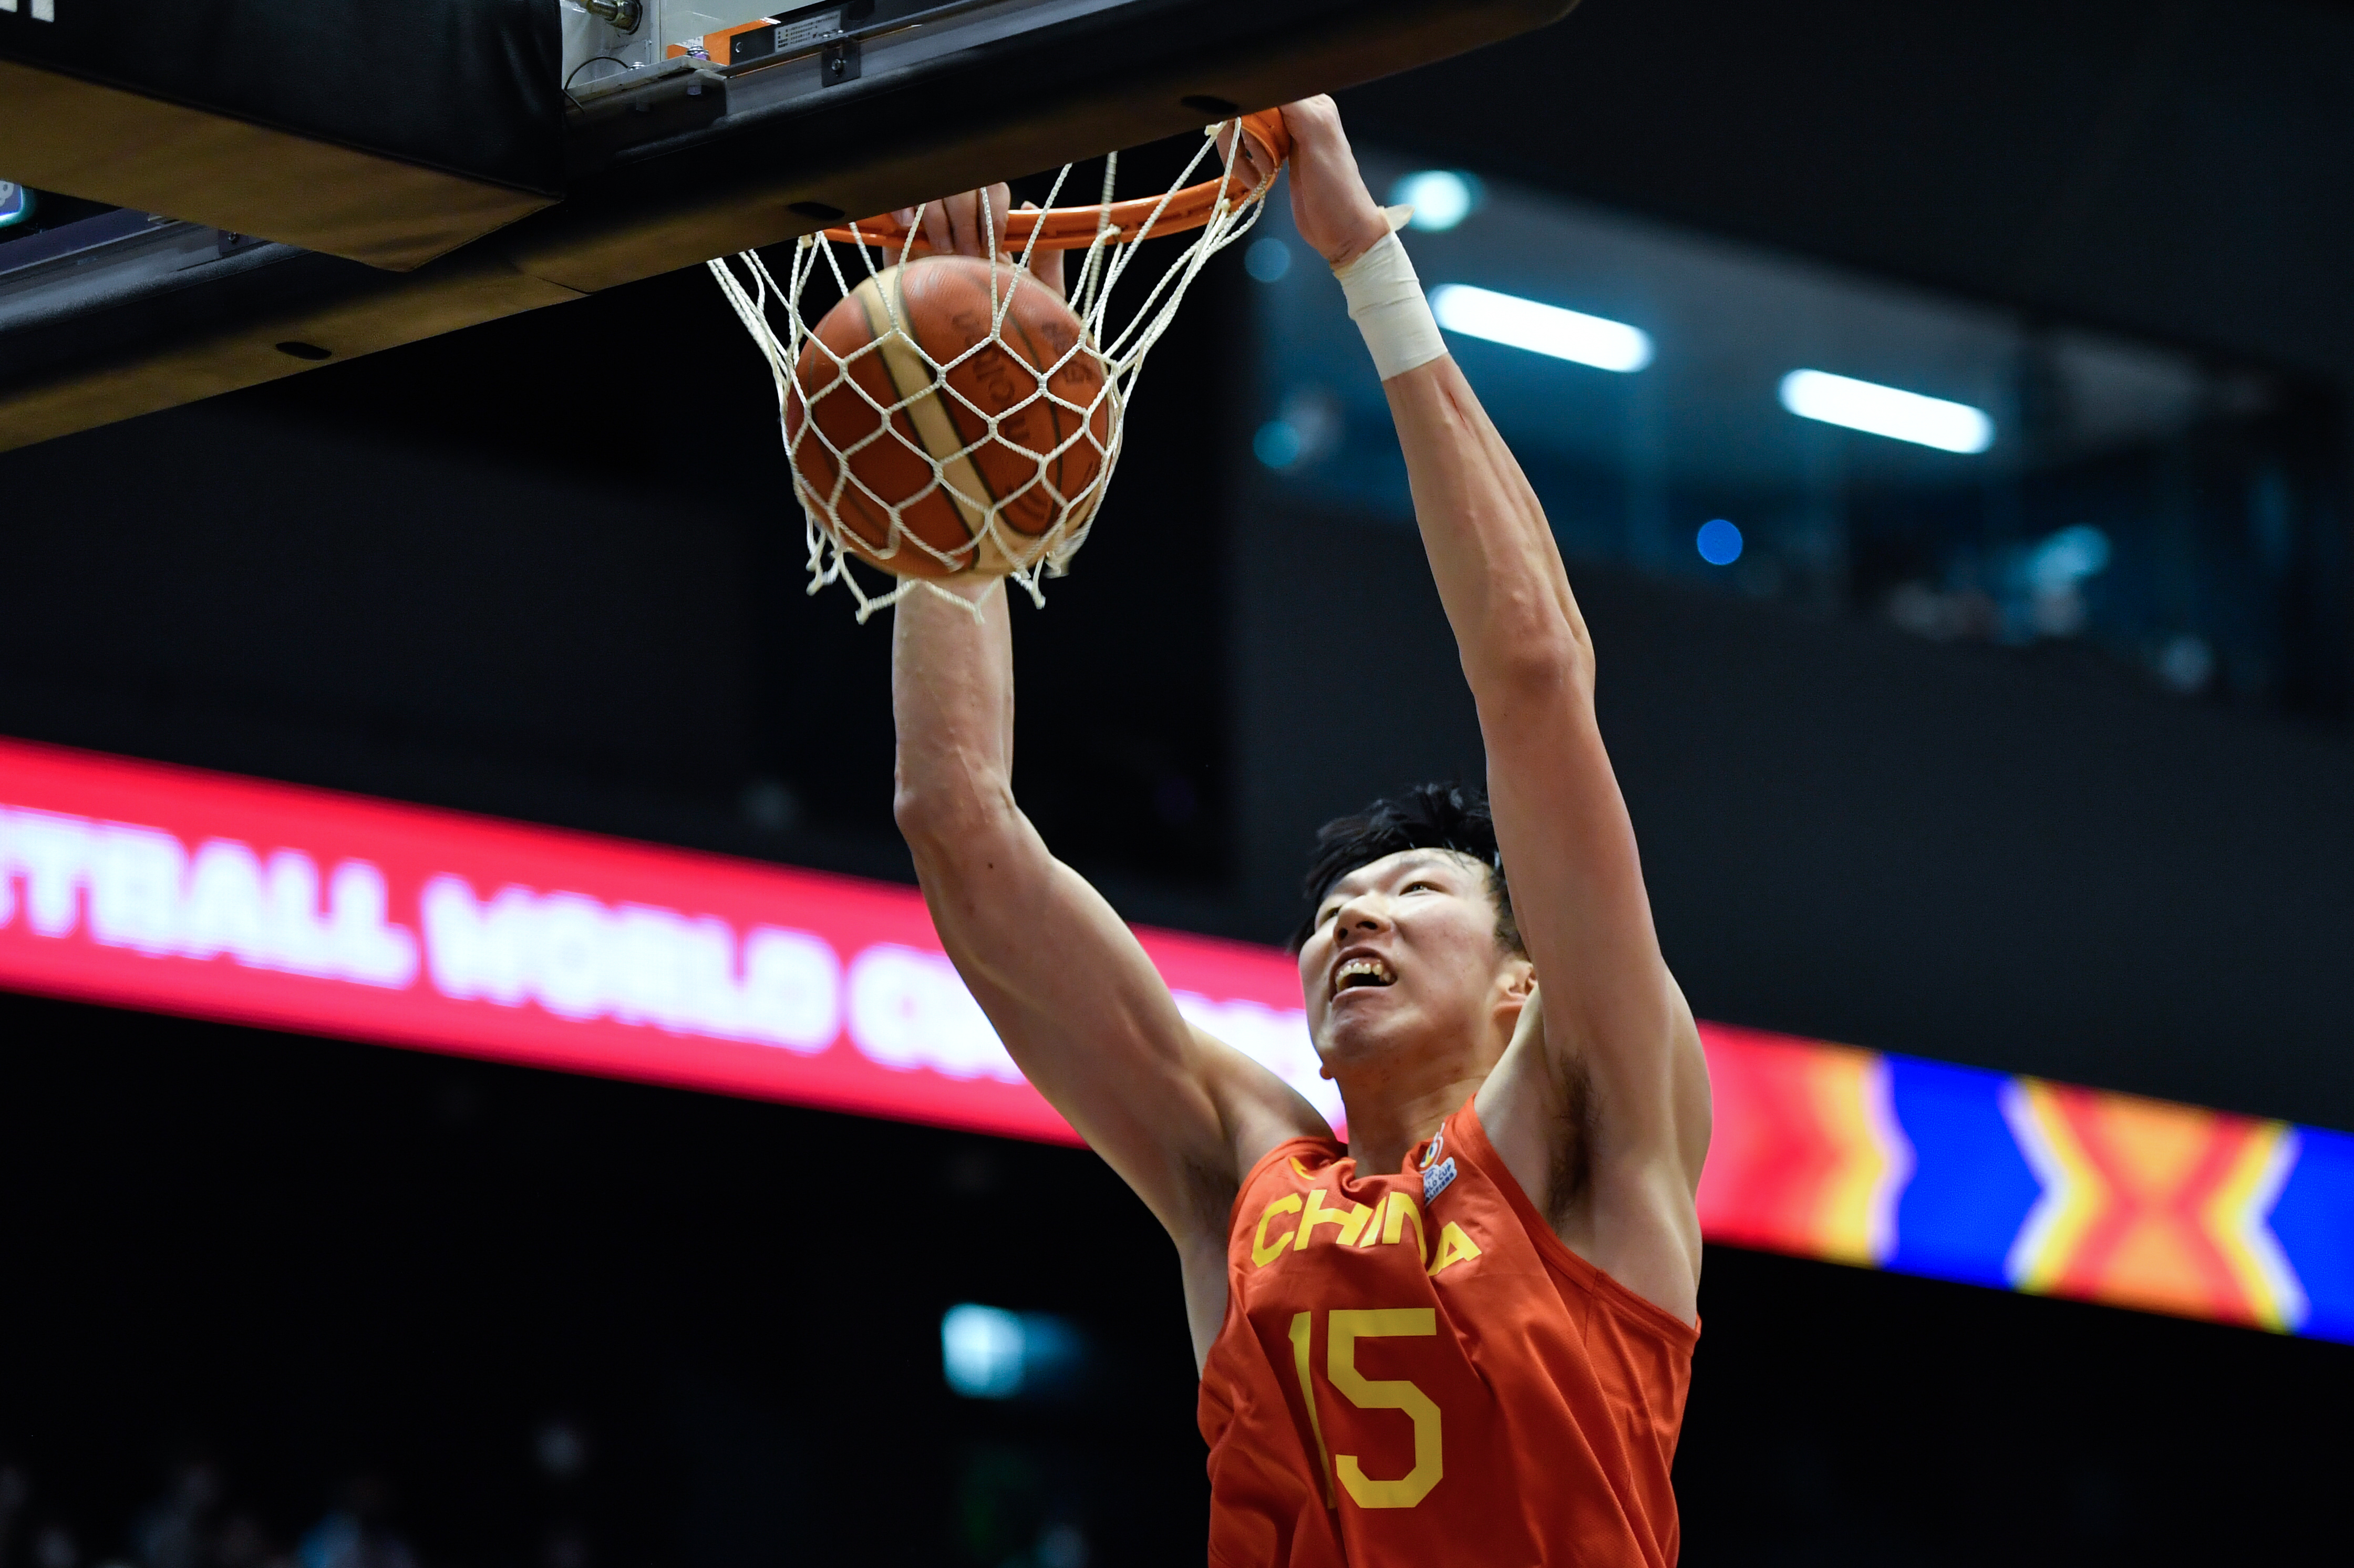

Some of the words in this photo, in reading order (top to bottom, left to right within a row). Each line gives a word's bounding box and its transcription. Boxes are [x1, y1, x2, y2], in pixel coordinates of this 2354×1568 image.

[0, 805, 417, 989] TBALL
[422, 872, 845, 1056] WORLD
[1251, 1189, 1482, 1276] CHINA
[1438, 1163, 1452, 1181] CUP
[1288, 1308, 1443, 1509] 15
